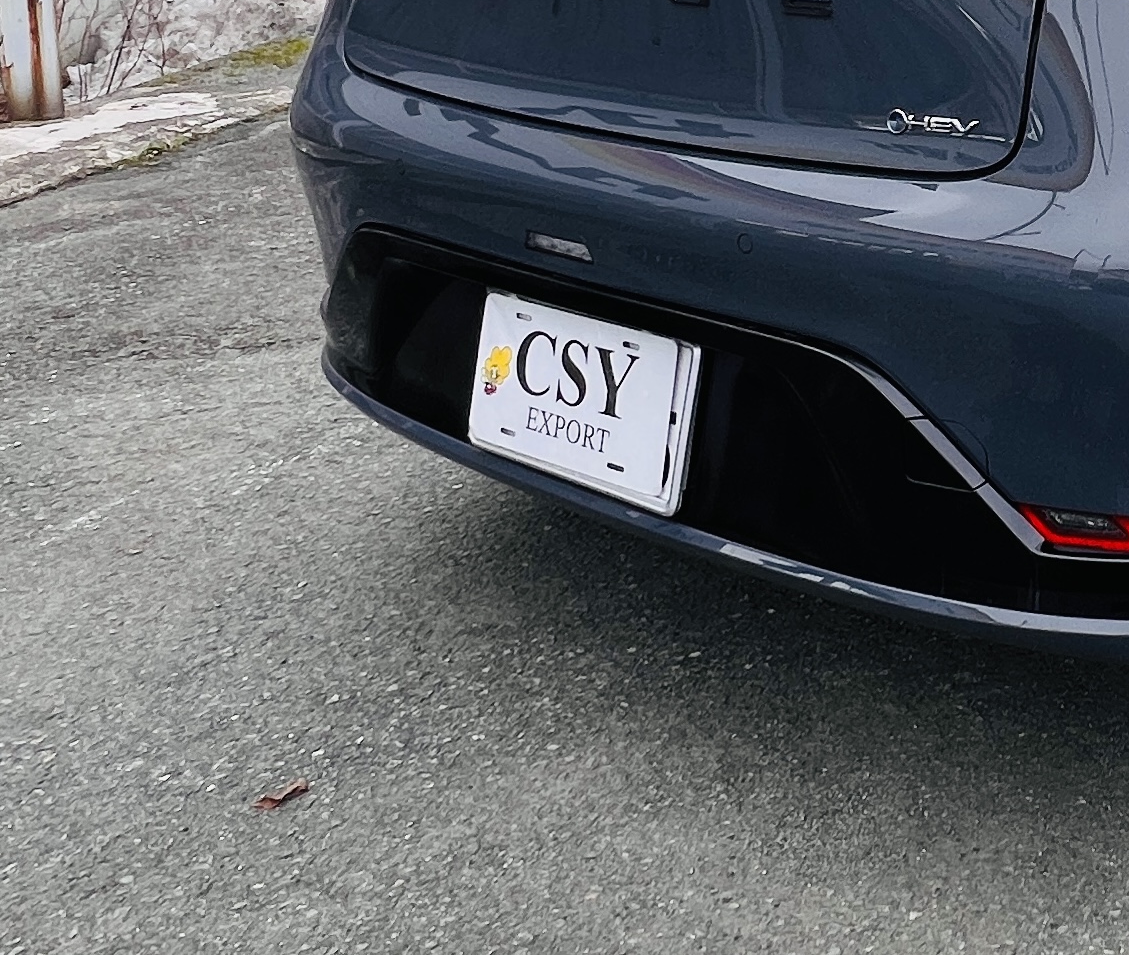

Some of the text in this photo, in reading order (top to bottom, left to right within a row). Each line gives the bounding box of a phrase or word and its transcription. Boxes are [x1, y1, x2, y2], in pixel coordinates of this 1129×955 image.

[905, 113, 980, 133] HEV
[516, 331, 640, 420] CSY
[525, 406, 611, 453] EXPORT
